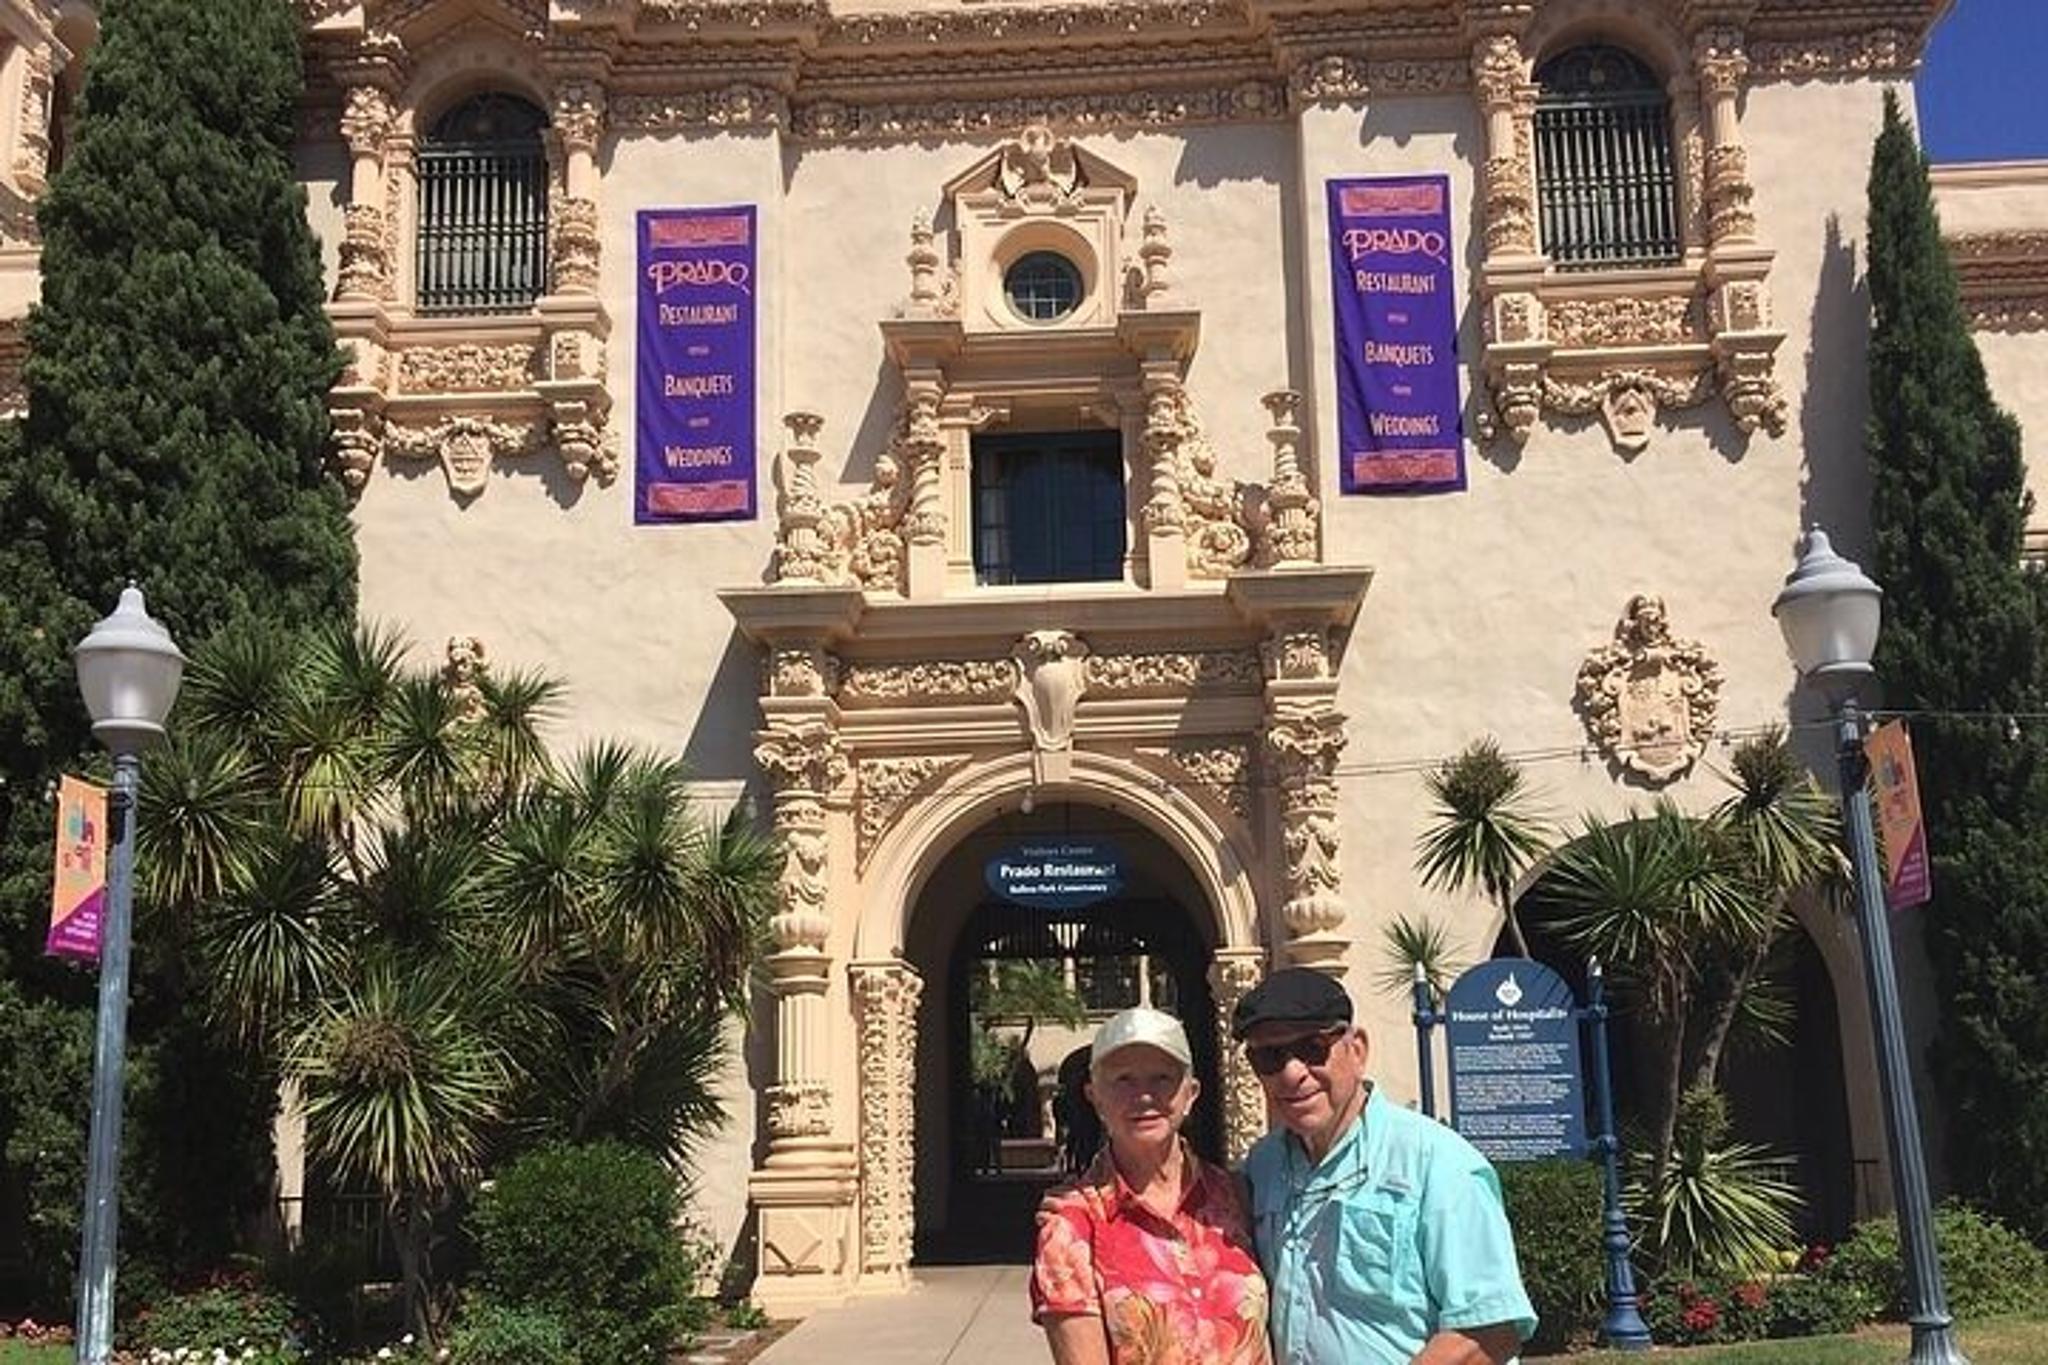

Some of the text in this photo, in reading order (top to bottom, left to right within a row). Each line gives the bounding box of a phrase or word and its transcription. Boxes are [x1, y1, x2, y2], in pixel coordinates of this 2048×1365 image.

[1342, 228, 1447, 265] PRADO
[648, 260, 750, 295] PRADO
[1356, 270, 1435, 294] RESTAURANT
[659, 303, 738, 325] RESTAURANT
[1364, 341, 1434, 367] BANQUETS
[664, 374, 733, 398] BANQUETS
[1370, 413, 1440, 436] WEDDINGS
[664, 446, 733, 467] WEDDINGS
[1000, 864, 1041, 878] Prado
[1453, 1010, 1489, 1022] House
[1490, 1008, 1504, 1021] of
